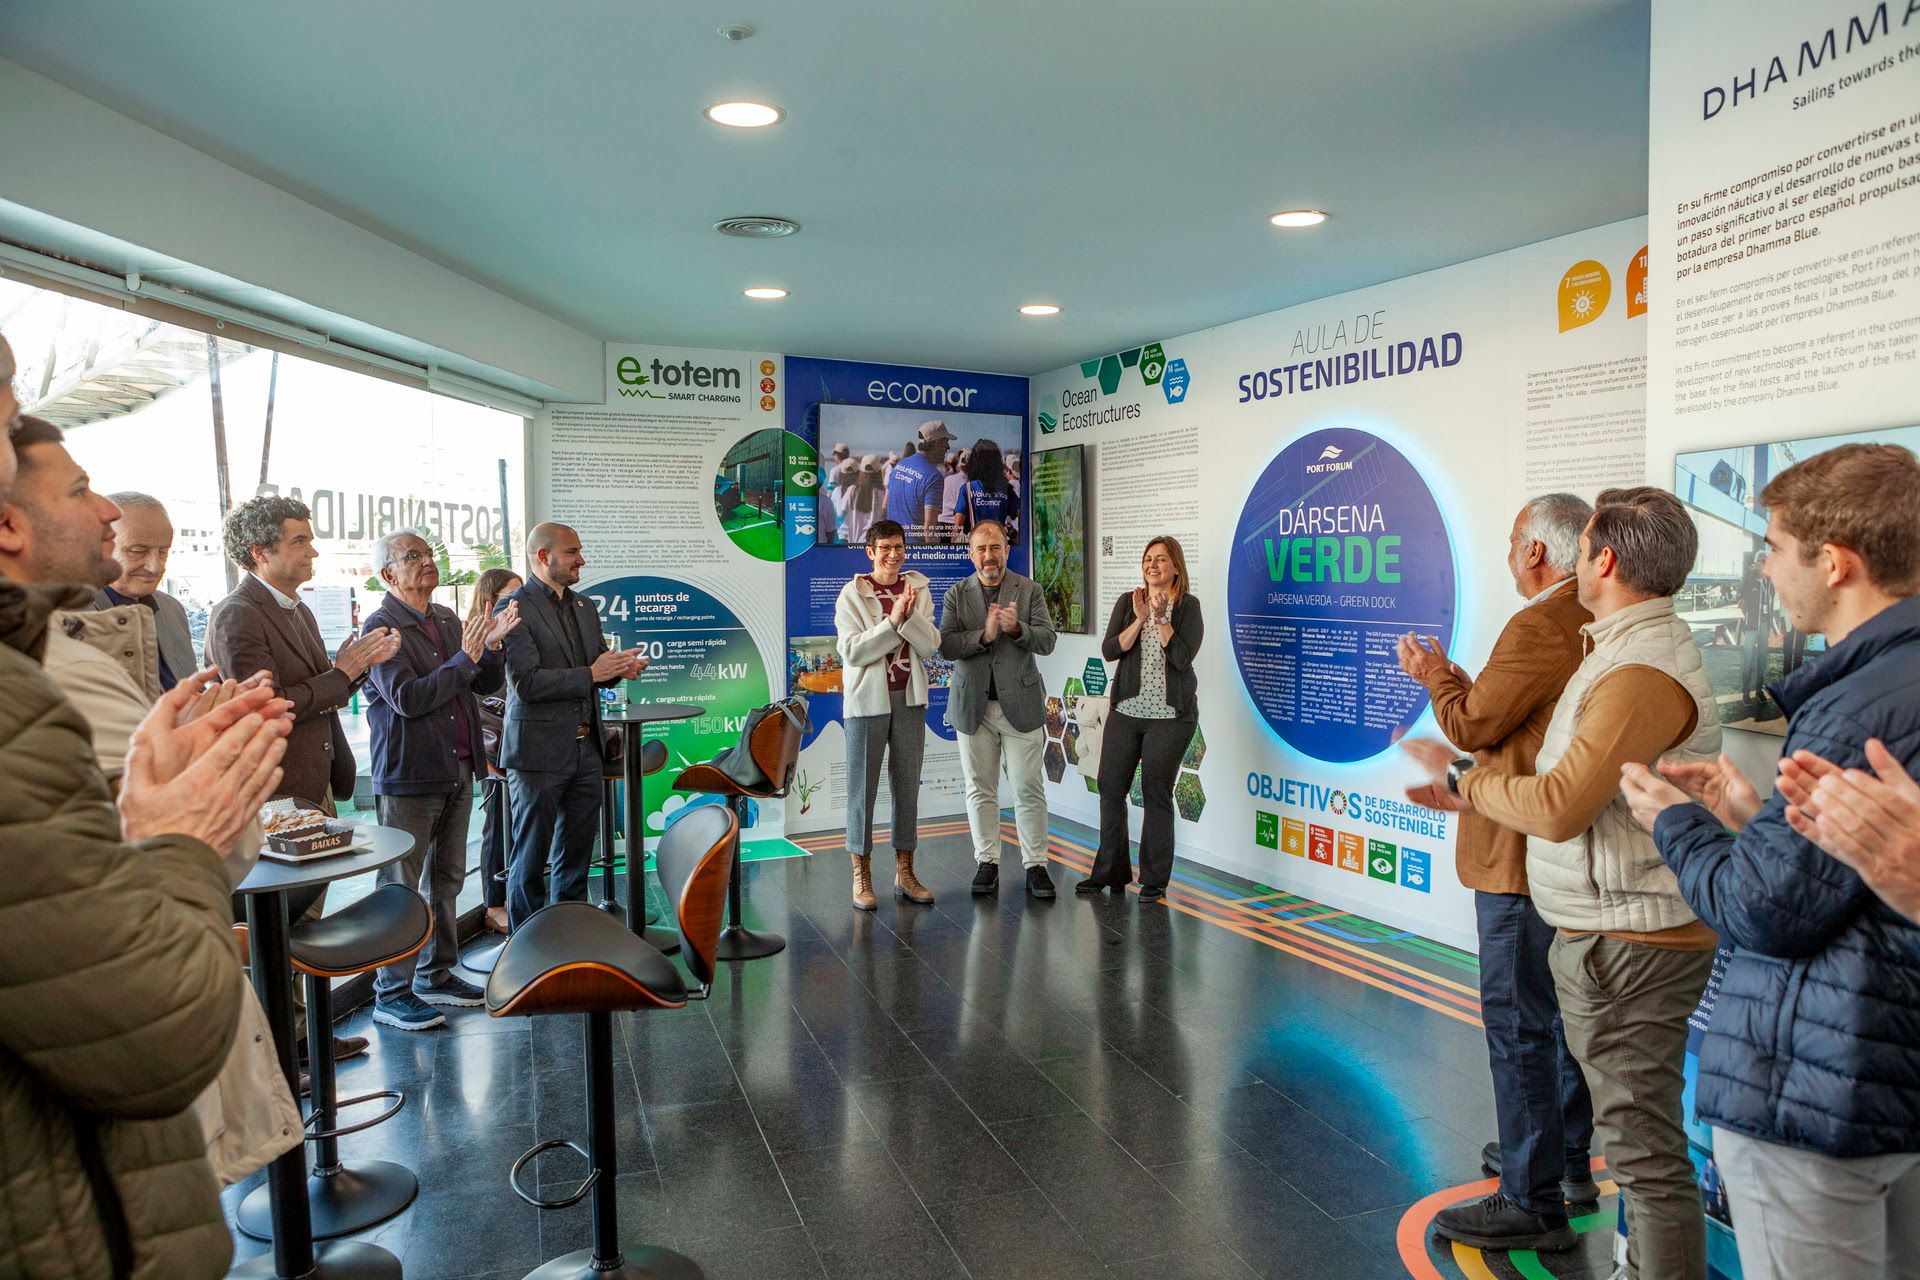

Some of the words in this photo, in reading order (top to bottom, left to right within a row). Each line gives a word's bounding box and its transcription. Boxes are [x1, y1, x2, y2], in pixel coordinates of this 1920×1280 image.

[1793, 84, 1834, 110] Sailing
[1839, 56, 1894, 89] towards
[1899, 44, 1920, 62] the
[1678, 204, 1688, 214] En
[1691, 199, 1700, 209] su
[1704, 189, 1727, 204] firme
[1731, 164, 1792, 194] compromiso
[1796, 154, 1814, 172] por
[1817, 127, 1885, 161] convertirse
[1890, 119, 1905, 133] en
[1678, 206, 1725, 230] innovación
[1728, 193, 1763, 212] náutica
[1766, 189, 1772, 201] y
[1775, 182, 1783, 195] el
[1786, 162, 1844, 191] desarrollo
[1847, 156, 1861, 168] de
[1865, 137, 1910, 161] nuevas
[1678, 237, 1687, 246] un
[1691, 228, 1712, 244] paso
[1716, 206, 1774, 233] significativo
[1779, 198, 1788, 211] al
[1792, 192, 1809, 207] ser
[1813, 177, 1855, 199] elegido
[1859, 163, 1893, 183] como
[1677, 243, 1717, 262] botadura
[1721, 234, 1735, 248] del
[1739, 225, 1772, 245] primer
[1776, 213, 1804, 230] barco
[1809, 194, 1855, 219] español
[1677, 268, 1691, 280] por
[1694, 264, 1701, 273] la
[1704, 251, 1743, 268] empresa
[1747, 236, 1791, 257] Dhamma
[1794, 227, 1820, 242] Blue.
[1566, 278, 1570, 288] 7
[1291, 320, 1347, 357] AULA
[1354, 310, 1386, 344] DE
[650, 358, 740, 389] totem
[1239, 332, 1463, 403] SOSTENIBILIDAD
[1676, 372, 1722, 388] development
[1725, 369, 1732, 379] of
[1735, 368, 1751, 376] new
[1812, 350, 1831, 361] Port
[1868, 340, 1885, 350] has
[1889, 334, 1918, 347] taken
[1690, 389, 1706, 399] base
[1724, 384, 1736, 393] the
[1740, 380, 1757, 389] final
[1760, 376, 1780, 386] tests
[1784, 370, 1800, 382] and
[1804, 369, 1818, 379] the
[1823, 361, 1854, 375] launch
[1859, 357, 1869, 369] of
[1873, 356, 1890, 366] the
[1895, 349, 1916, 361] first
[668, 392, 695, 401] SMART
[698, 393, 741, 403] CHARGING
[868, 380, 977, 407] ecomar
[1063, 387, 1097, 408] Ocean
[1724, 398, 1736, 407] the
[1738, 391, 1774, 404] company
[1776, 385, 1815, 398] Dhamma
[1063, 403, 1140, 431] Ecostructures
[789, 456, 796, 465] 13
[1307, 464, 1325, 473] PORT
[1326, 462, 1353, 471] FORUM
[789, 503, 796, 511] 14
[1279, 501, 1385, 535] DÁRSENA
[1264, 535, 1401, 583] VERDE
[588, 595, 630, 621] 24
[635, 593, 673, 604] puntos
[676, 592, 689, 602] de
[635, 604, 677, 614] recarga
[1303, 595, 1332, 606] VERDA
[1340, 595, 1369, 607] GREEN
[1371, 596, 1396, 608] DOCK
[636, 641, 663, 659] 20
[1247, 772, 1362, 819] OBJETIVOS
[1365, 796, 1377, 808] DE
[1379, 798, 1446, 823] DESARROLLO
[1365, 808, 1445, 840] SOSTENIBLE
[311, 837, 341, 850] BAIXAS
[1370, 842, 1376, 851] 13
[1403, 850, 1409, 859] 14
